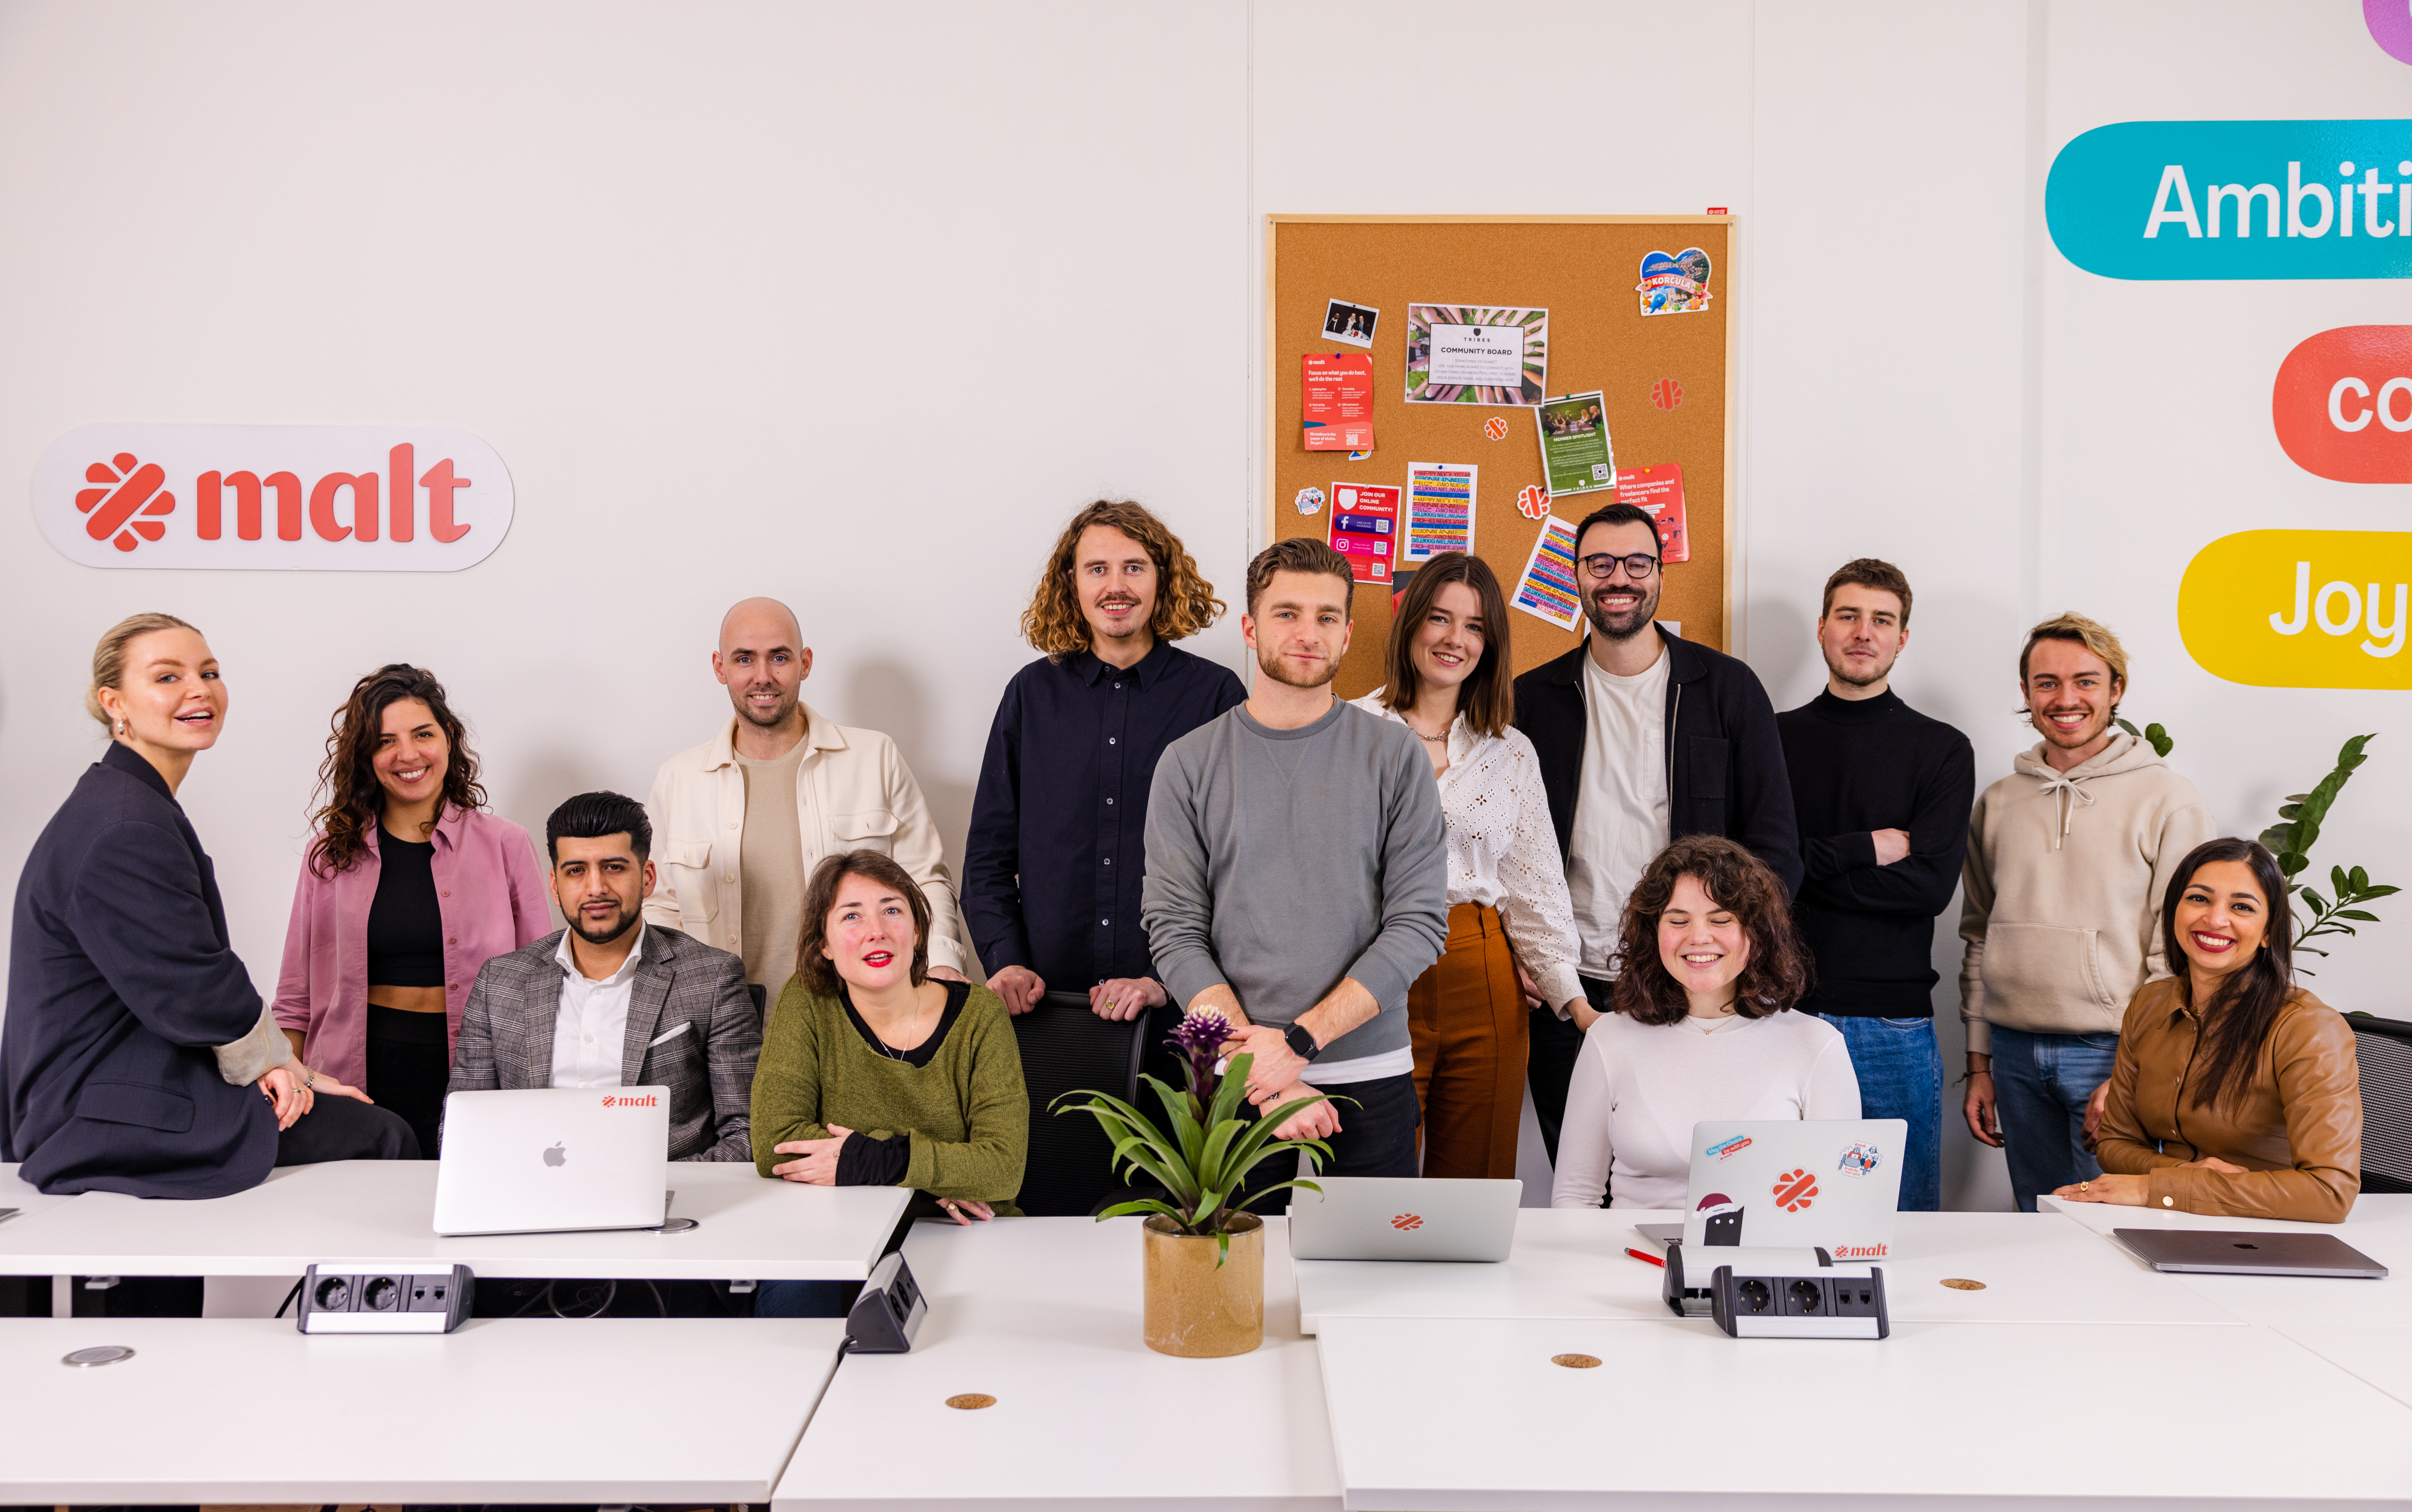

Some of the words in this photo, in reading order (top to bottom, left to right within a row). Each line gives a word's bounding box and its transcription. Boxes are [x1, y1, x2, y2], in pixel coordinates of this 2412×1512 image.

[2143, 160, 2412, 238] Ambiti
[1652, 275, 1691, 289] KORČULA
[2328, 377, 2412, 433] co
[1637, 479, 1664, 489] companies
[197, 443, 471, 543] malt
[1619, 489, 1649, 498] freelancers
[1621, 497, 1641, 505] perfect
[1523, 586, 1547, 600] GELUKKIG
[1546, 596, 1574, 612] NIEUWJAAR
[1543, 601, 1558, 611] NEUES
[1558, 607, 1574, 617] JAHR
[2269, 561, 2408, 658] Joy
[619, 1094, 658, 1106] malt
[1727, 1137, 1742, 1145] Choice
[1850, 1242, 1888, 1257] malt
